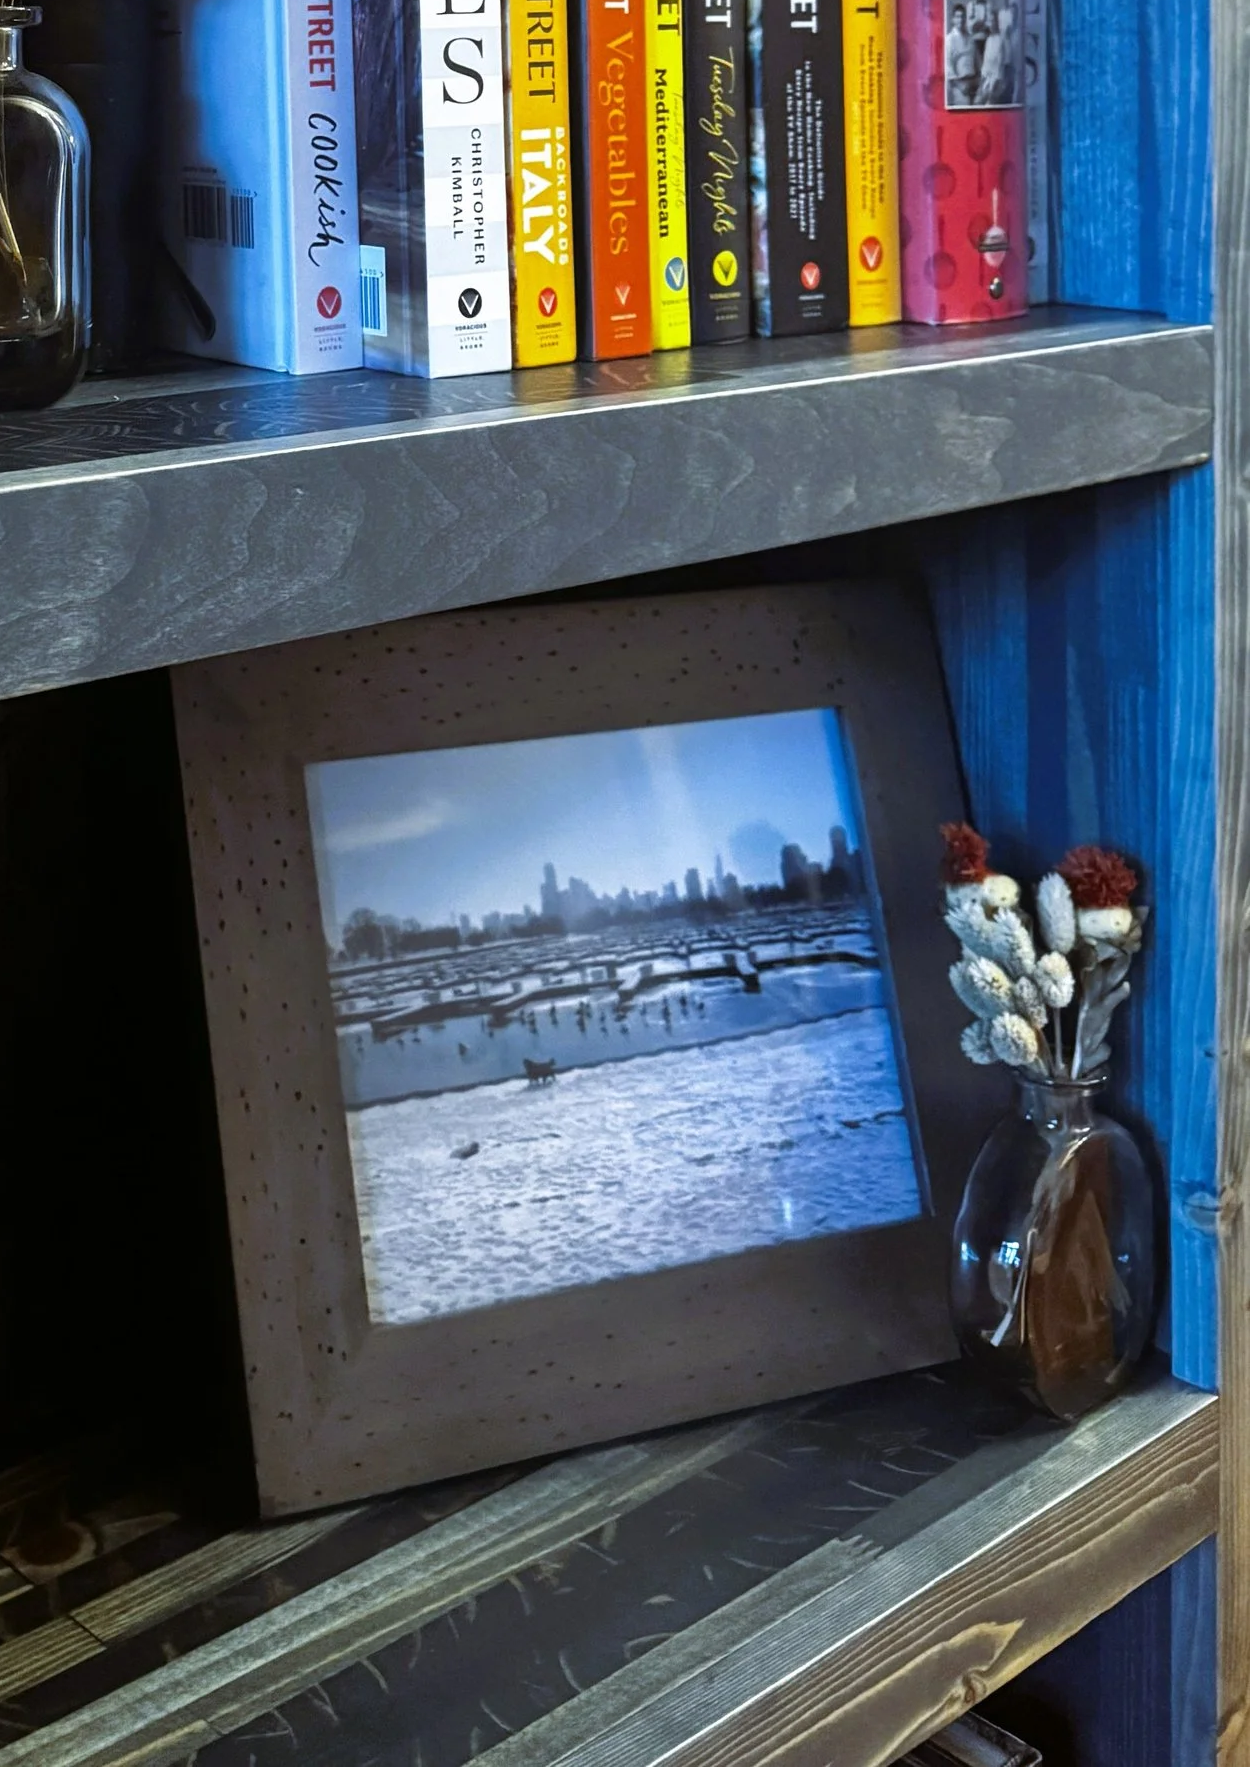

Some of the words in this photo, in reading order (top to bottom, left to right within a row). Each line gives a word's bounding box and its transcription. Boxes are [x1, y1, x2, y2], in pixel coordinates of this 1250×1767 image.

[598, 30, 638, 255] Vegetables
[654, 68, 669, 238] Mediterranean
[699, 46, 737, 138] Tuesday
[451, 156, 463, 240] KIMBALL
[470, 128, 486, 265] CHRISTOPHER
[520, 128, 555, 265] ITALY
[554, 127, 569, 266] BACKROADS
[700, 138, 741, 237] Nights
